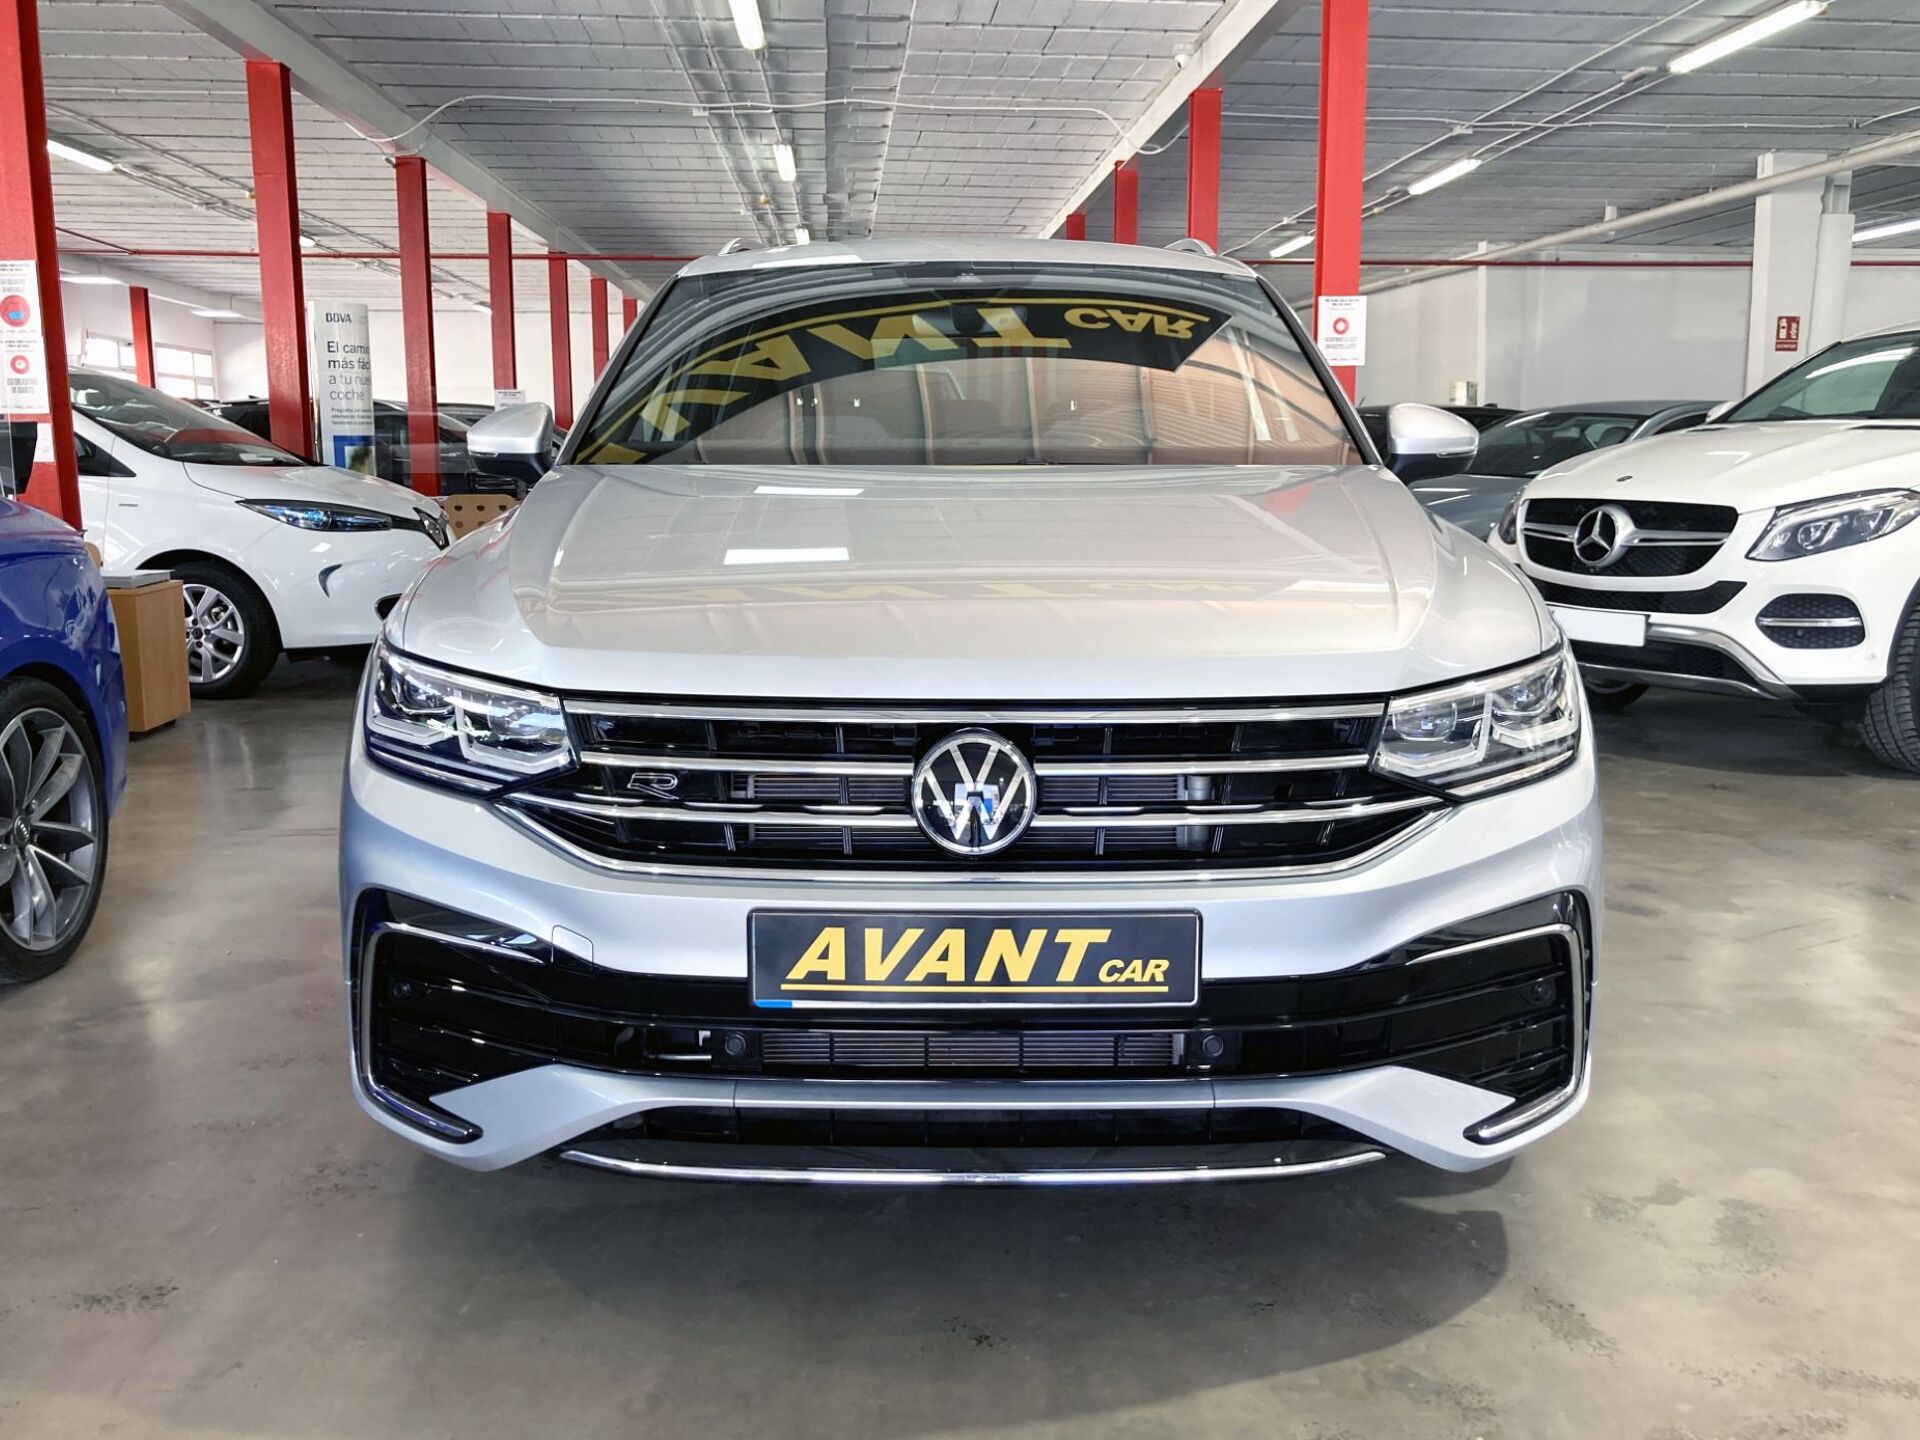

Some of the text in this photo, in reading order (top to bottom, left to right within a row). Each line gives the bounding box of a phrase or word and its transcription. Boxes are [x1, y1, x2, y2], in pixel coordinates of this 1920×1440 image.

[325, 312, 352, 323] BBVA
[327, 340, 339, 353] El
[328, 357, 355, 369] más
[329, 375, 337, 385] a
[340, 374, 352, 385] tu
[330, 389, 365, 401] coche
[785, 926, 1170, 983] AVANT CAR
